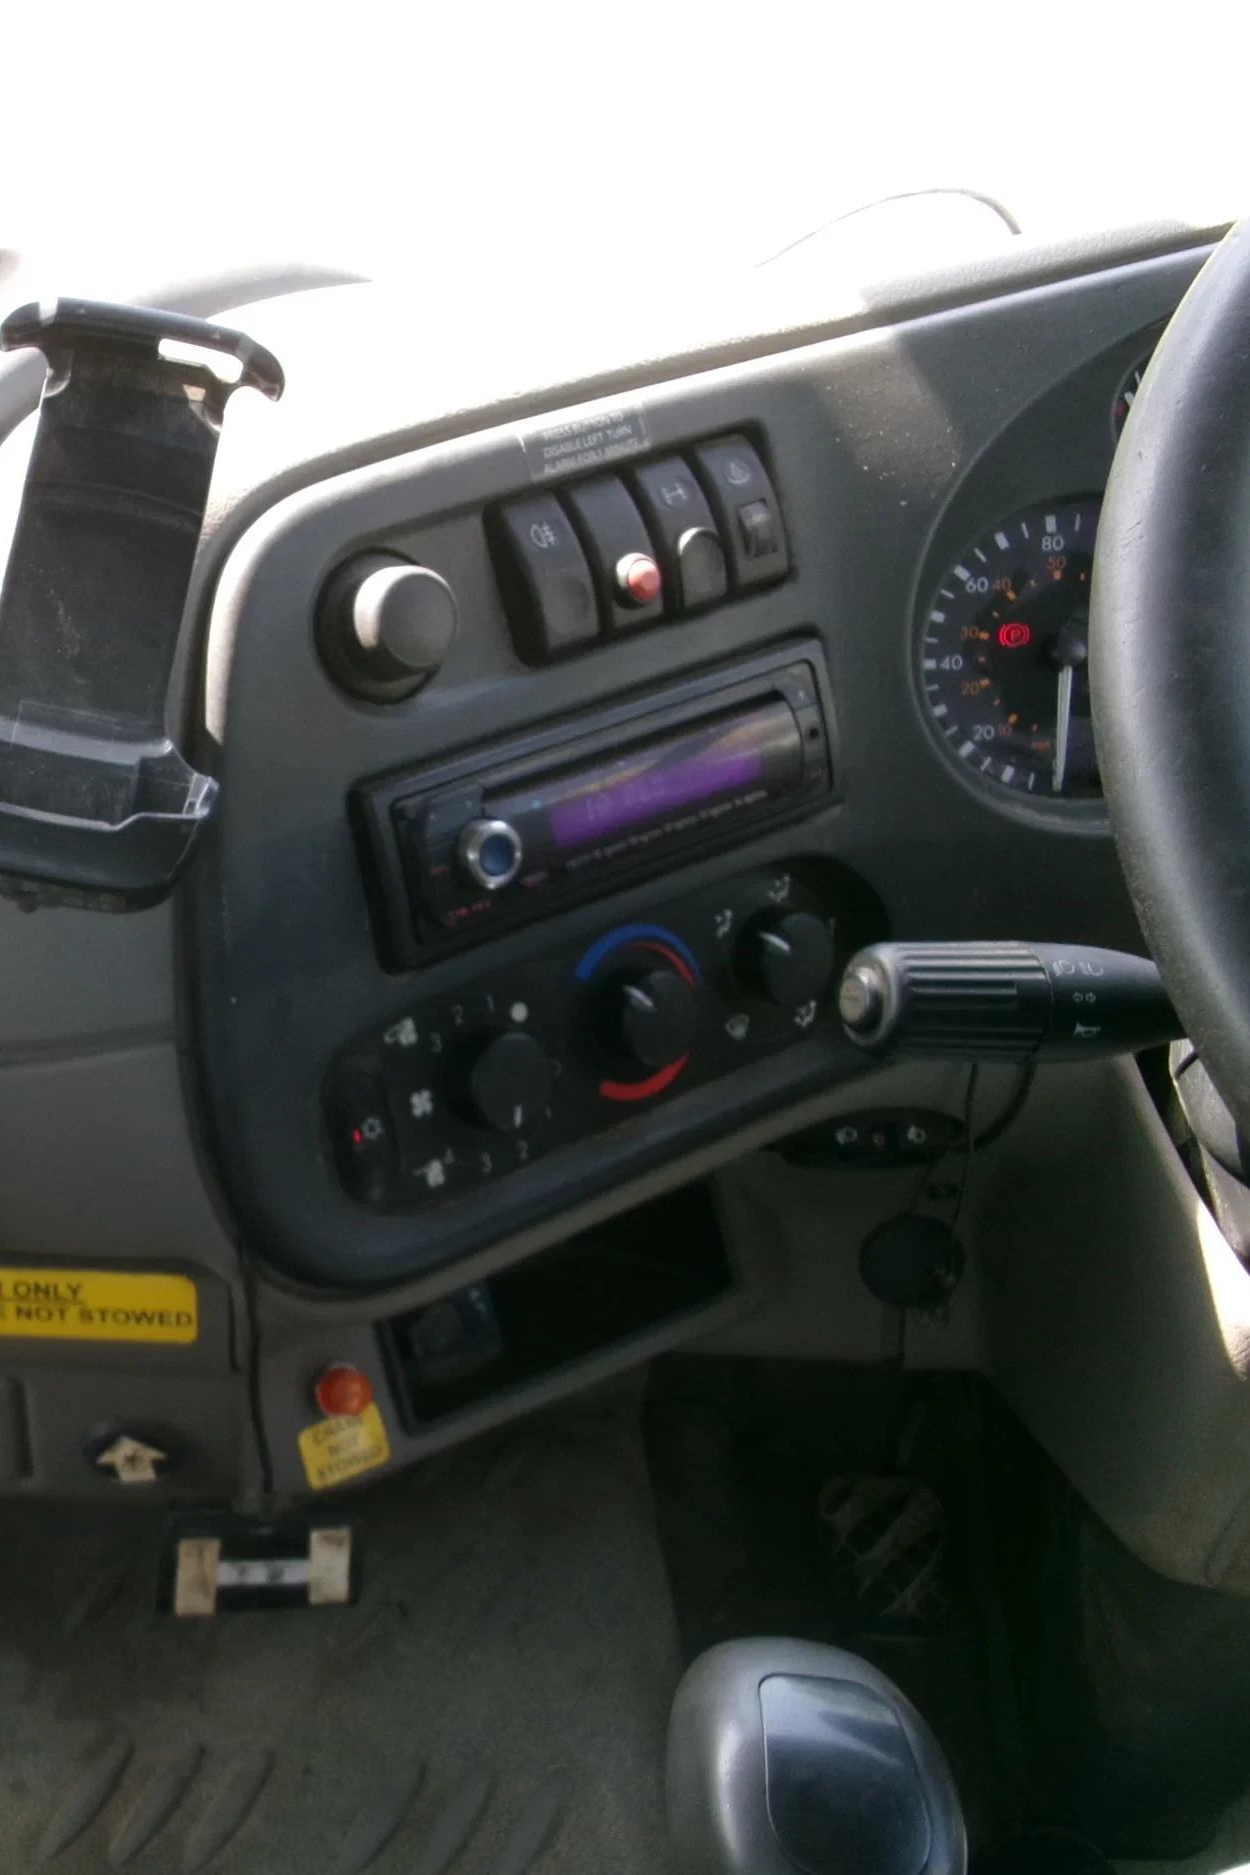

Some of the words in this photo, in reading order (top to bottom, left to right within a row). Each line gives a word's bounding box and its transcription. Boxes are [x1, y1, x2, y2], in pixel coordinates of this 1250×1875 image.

[1041, 535, 1065, 551] 80
[965, 578, 988, 593] 60
[993, 578, 1012, 590] 40
[940, 656, 963, 670] 40
[961, 682, 980, 694] 20
[973, 724, 995, 740] 20
[13, 1281, 84, 1301] ONLY
[16, 1305, 69, 1324] NOT
[79, 1308, 193, 1329] STOWED
